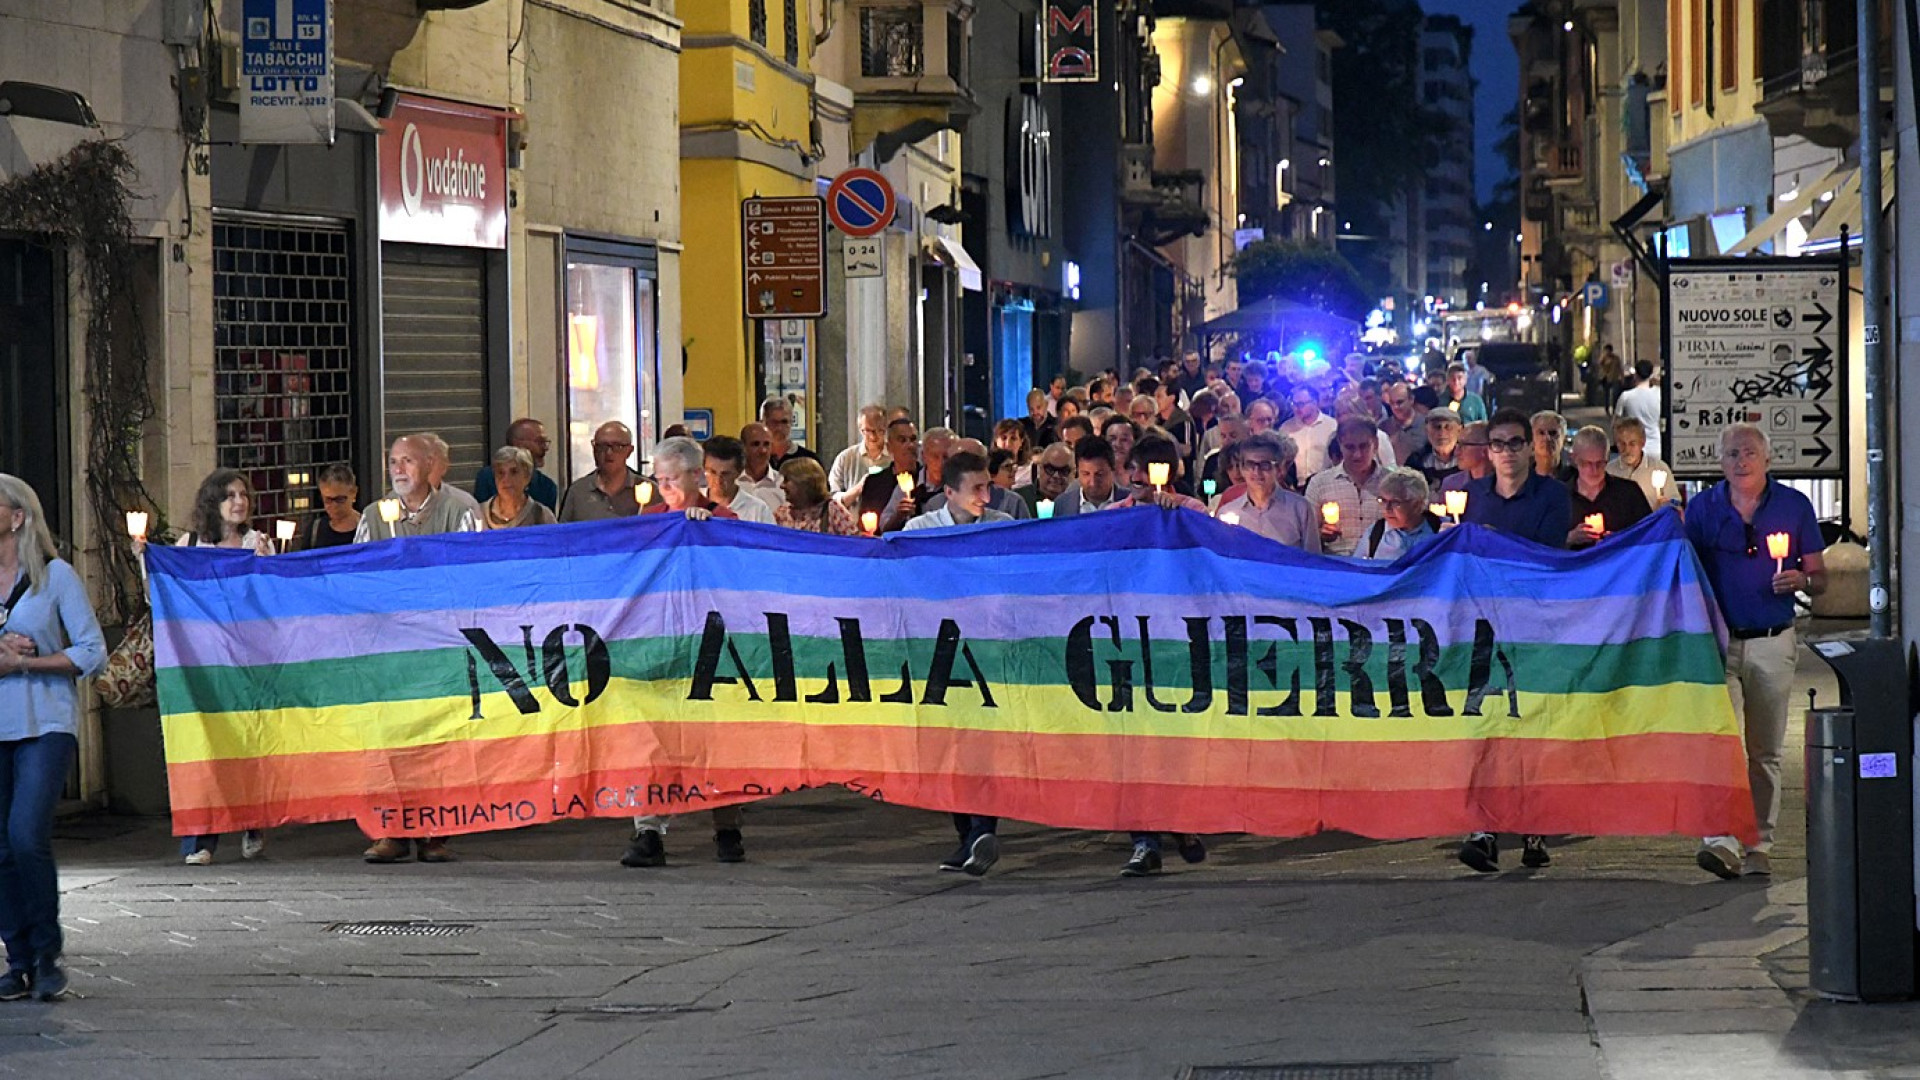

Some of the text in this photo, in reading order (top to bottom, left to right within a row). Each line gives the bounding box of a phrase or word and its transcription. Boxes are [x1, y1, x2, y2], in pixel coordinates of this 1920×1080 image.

[302, 27, 315, 37] 15
[269, 41, 302, 51] SALI E
[245, 52, 323, 66] TABACCHI
[251, 76, 317, 91] LOTTO
[425, 147, 486, 200] vodafone
[1588, 284, 1603, 304] P
[1679, 308, 1768, 322] NUOVO SOLE
[458, 611, 1521, 721] NO ALLA GUERRA
[552, 794, 587, 816] LA
